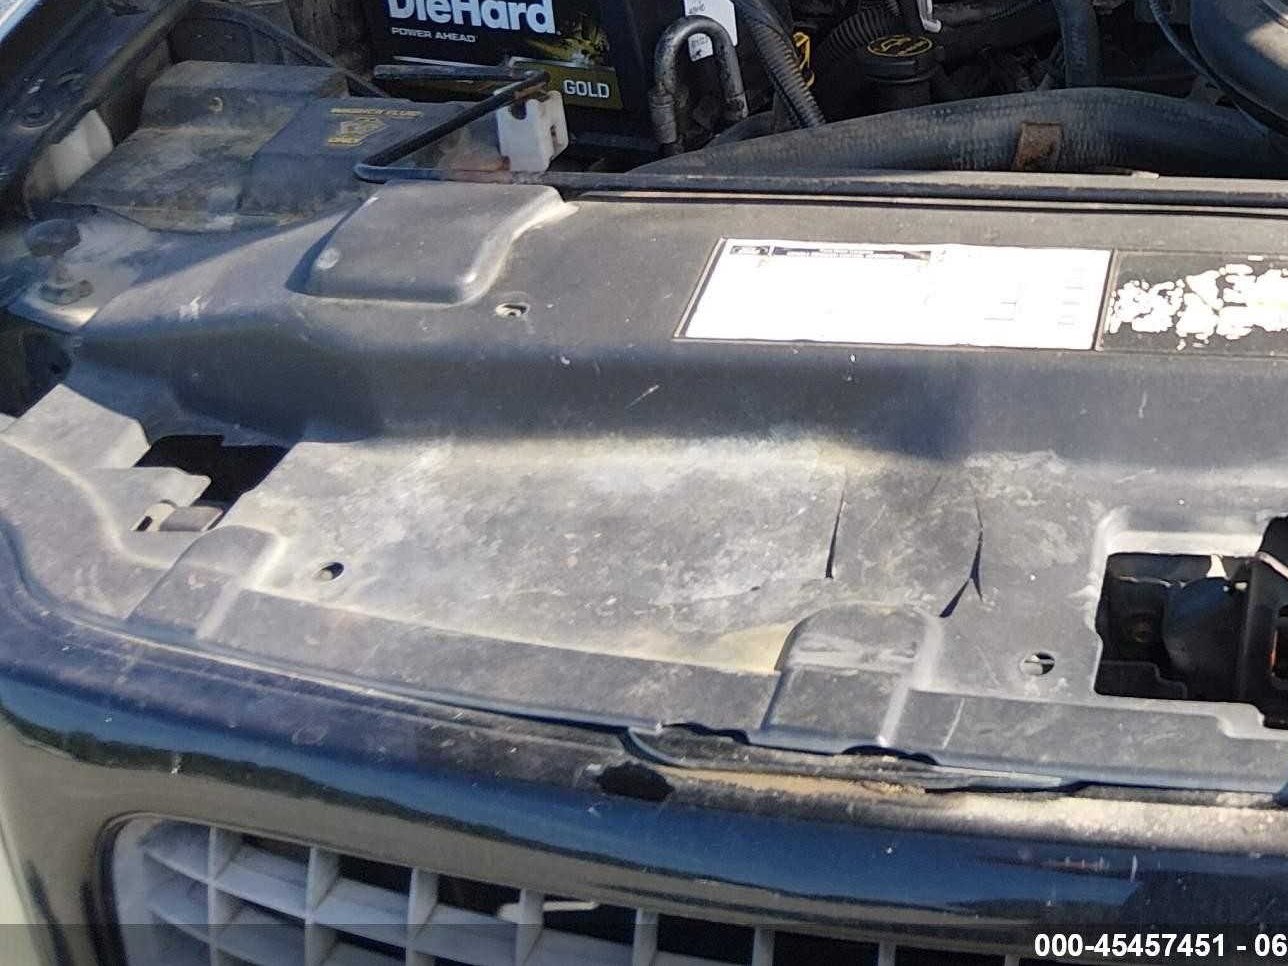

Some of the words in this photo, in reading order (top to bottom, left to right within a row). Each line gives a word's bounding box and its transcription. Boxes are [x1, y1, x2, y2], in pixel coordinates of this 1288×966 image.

[391, 27, 432, 38] POWER
[435, 32, 476, 43] AHEAD
[563, 79, 609, 99] GOLD
